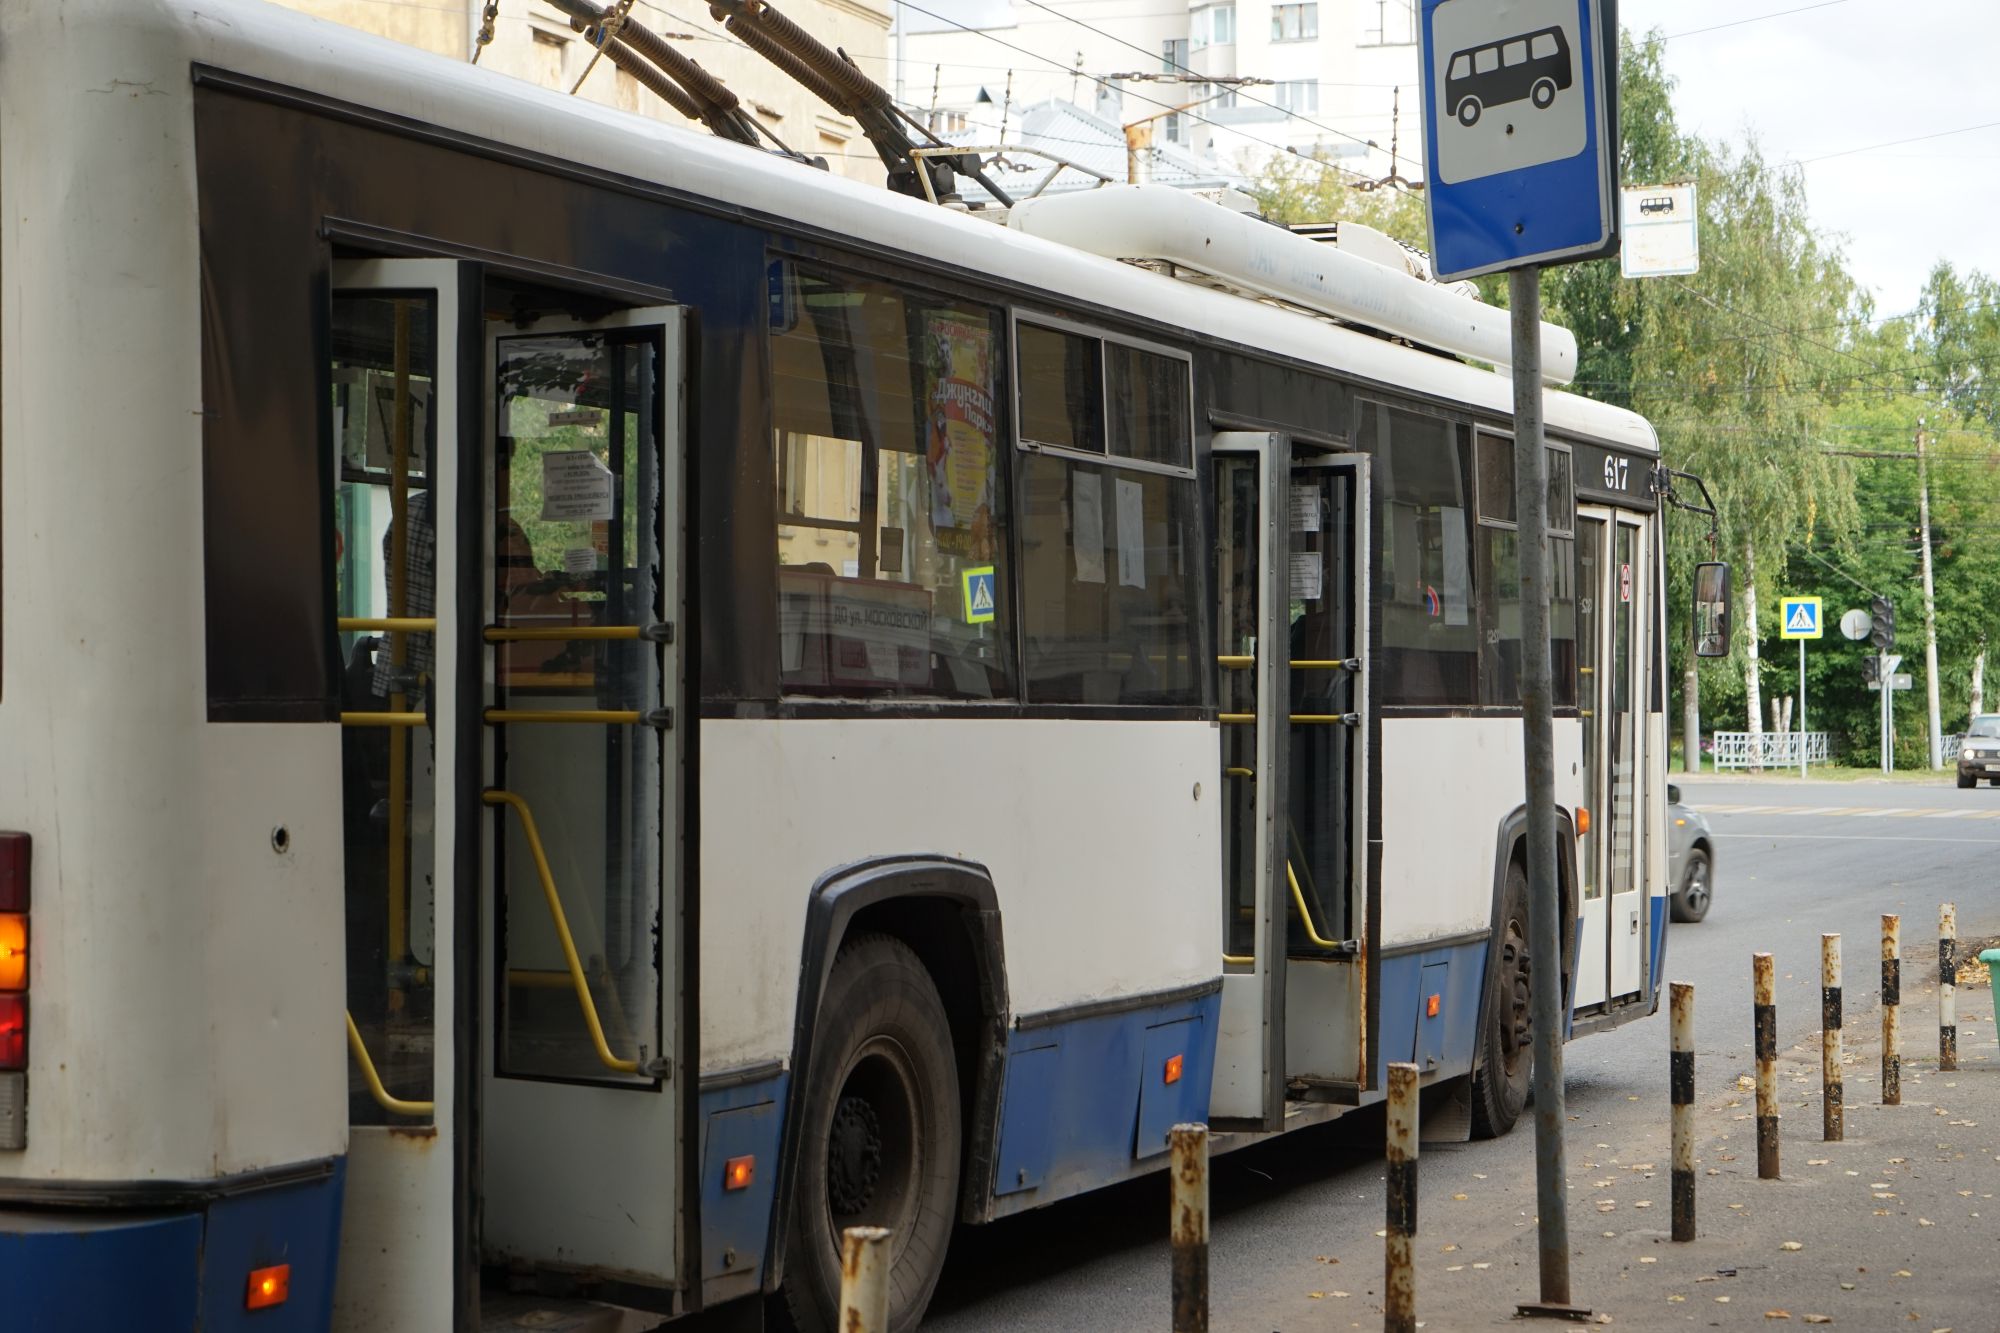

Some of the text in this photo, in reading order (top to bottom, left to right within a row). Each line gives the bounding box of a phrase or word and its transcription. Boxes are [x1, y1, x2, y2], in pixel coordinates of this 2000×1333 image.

[1604, 454, 1628, 491] 617
[834, 605, 848, 625] ДО
[865, 607, 928, 631] МОСКОВСКОЙ
